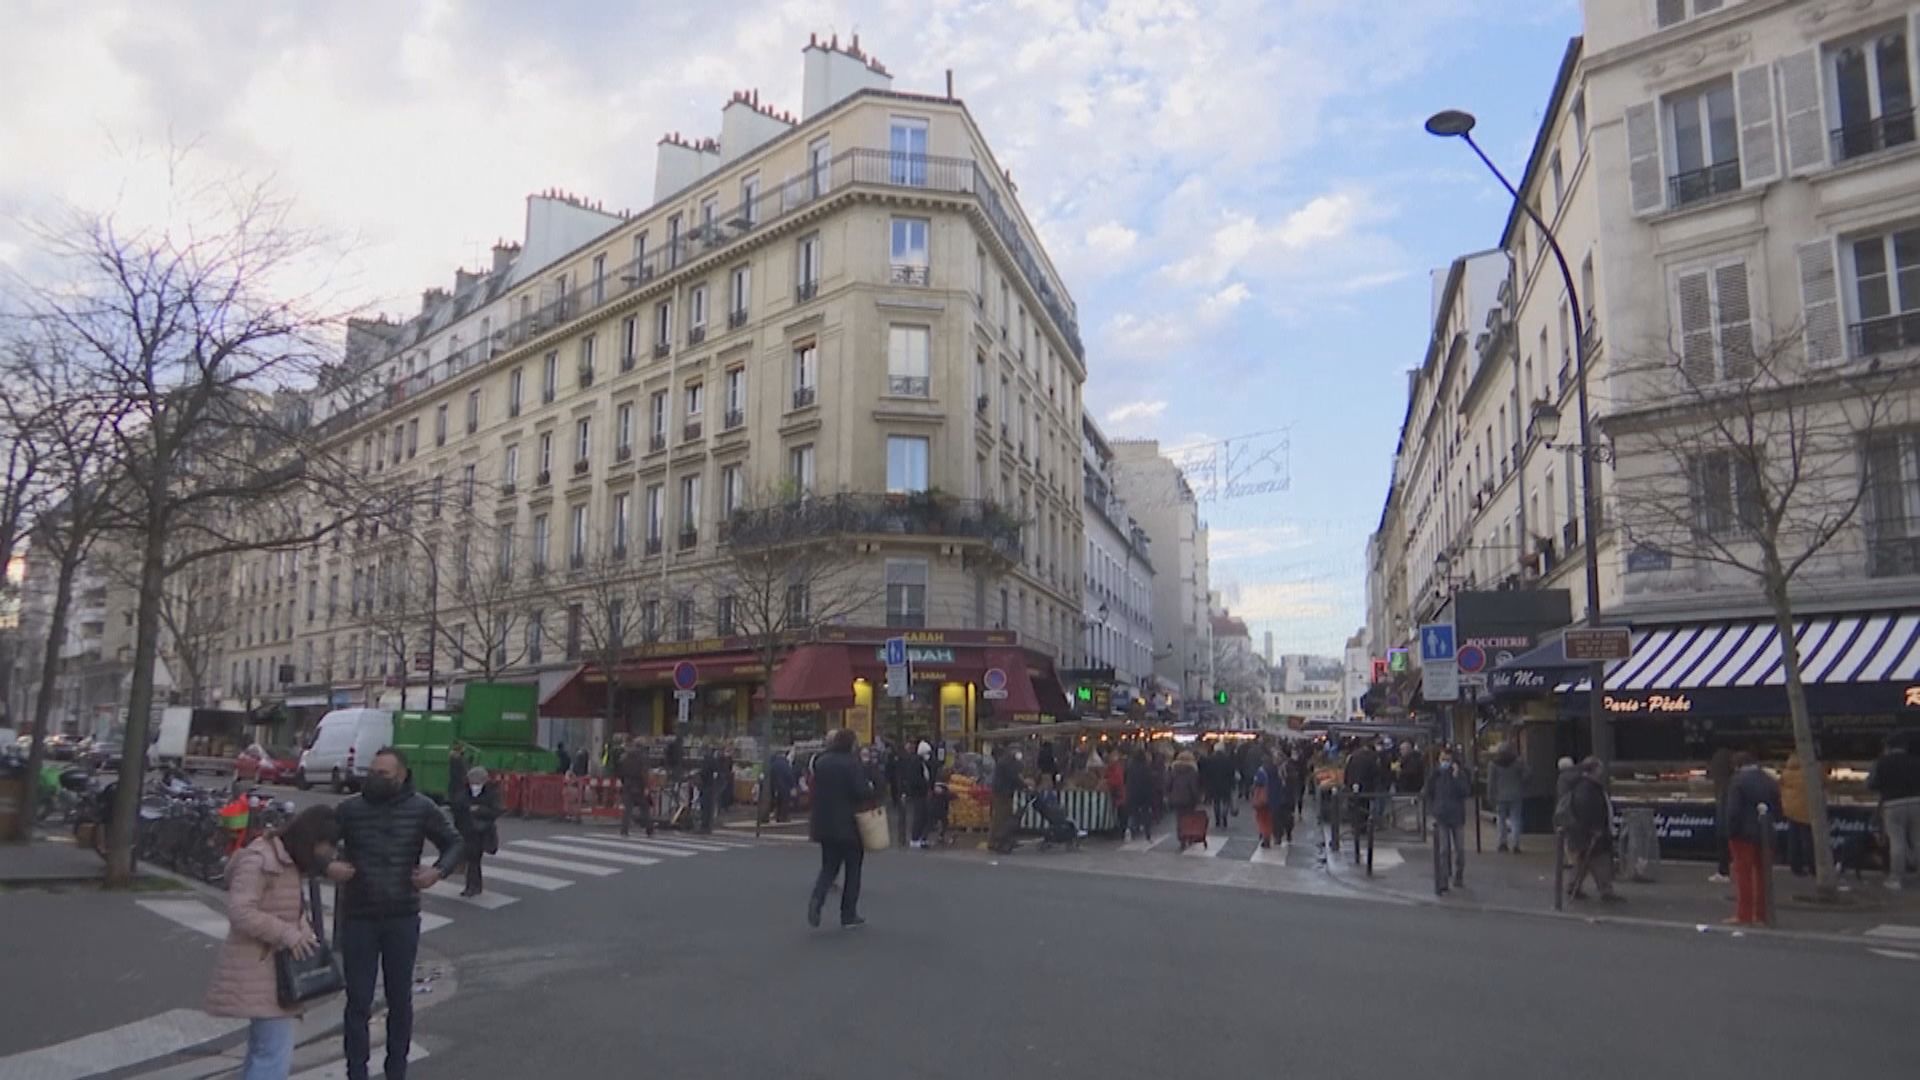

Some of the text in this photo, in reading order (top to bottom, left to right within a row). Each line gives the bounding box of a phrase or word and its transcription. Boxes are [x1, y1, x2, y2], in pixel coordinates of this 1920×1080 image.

[903, 632, 944, 643] SABAH
[1466, 637, 1529, 649] BOUCHERIE
[879, 648, 953, 662] SBAH
[1513, 669, 1545, 686] Mer
[1664, 813, 1714, 829] poissons
